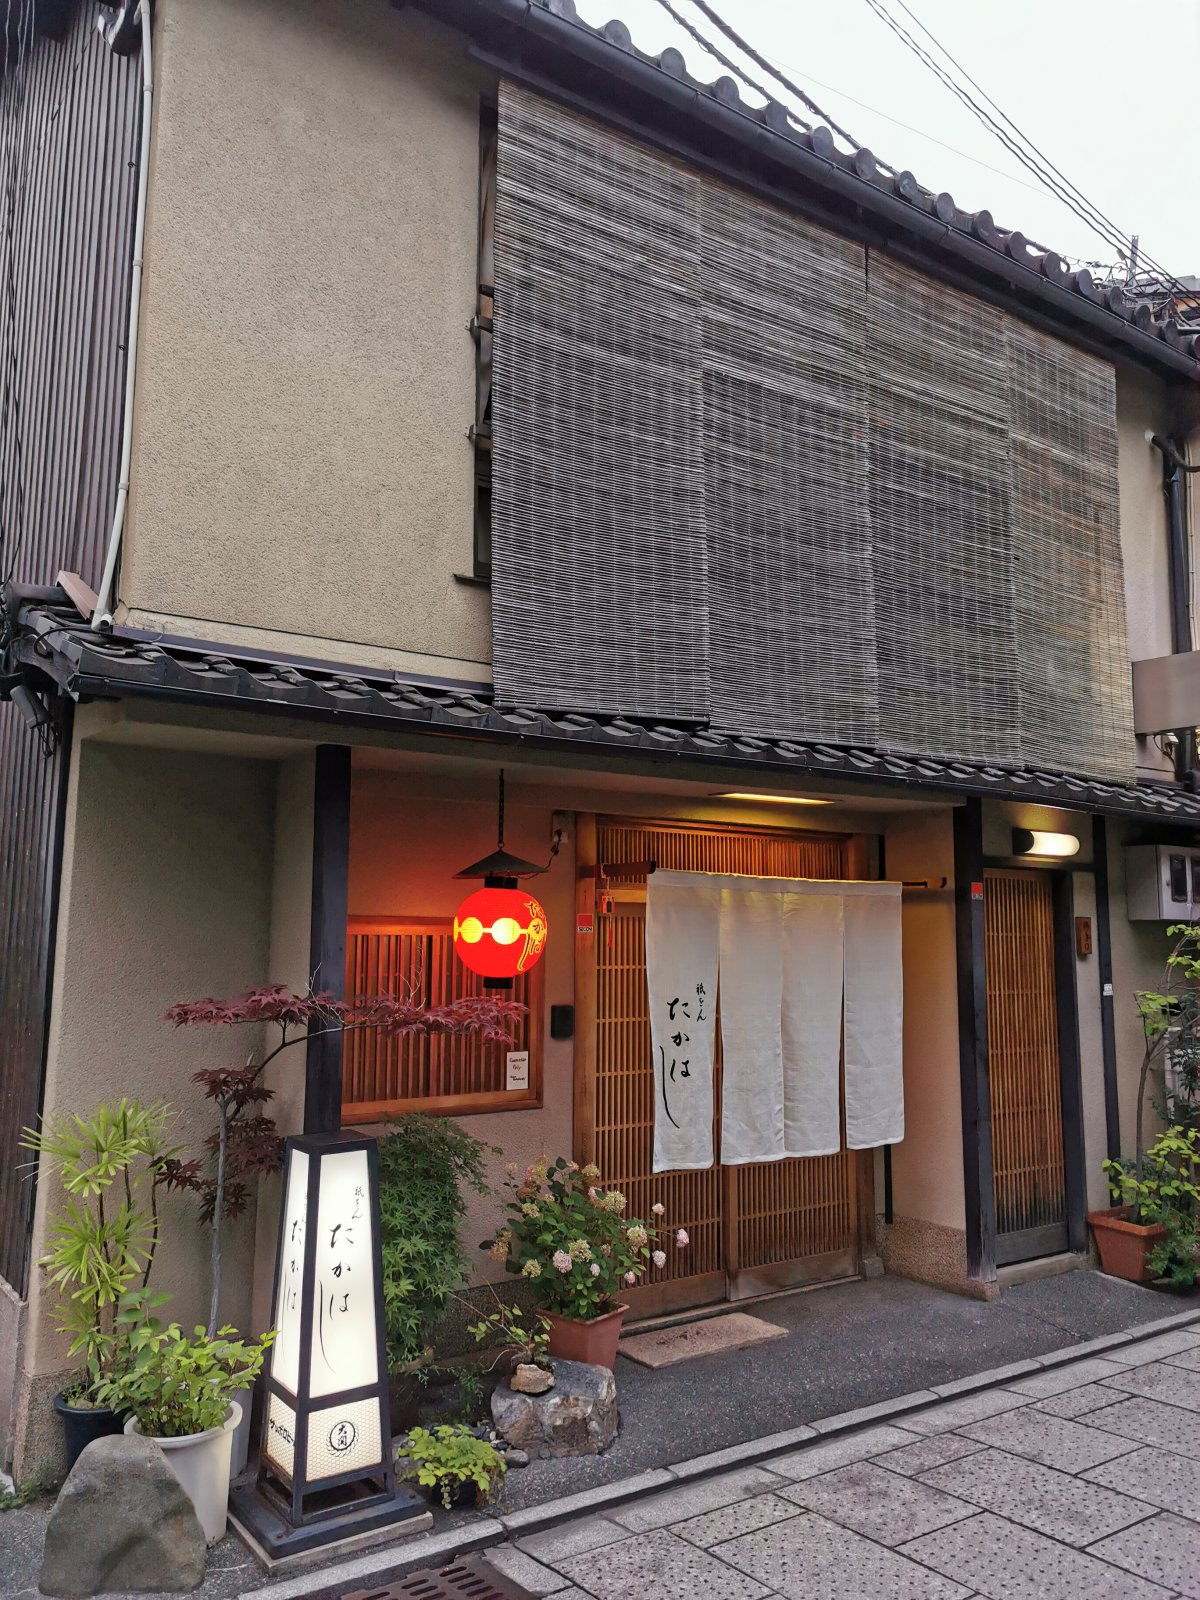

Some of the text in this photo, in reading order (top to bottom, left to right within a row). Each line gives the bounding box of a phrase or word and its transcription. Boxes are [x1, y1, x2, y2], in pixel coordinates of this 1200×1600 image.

[659, 997, 691, 1129] たかはし
[318, 1223, 354, 1373] たかはし
